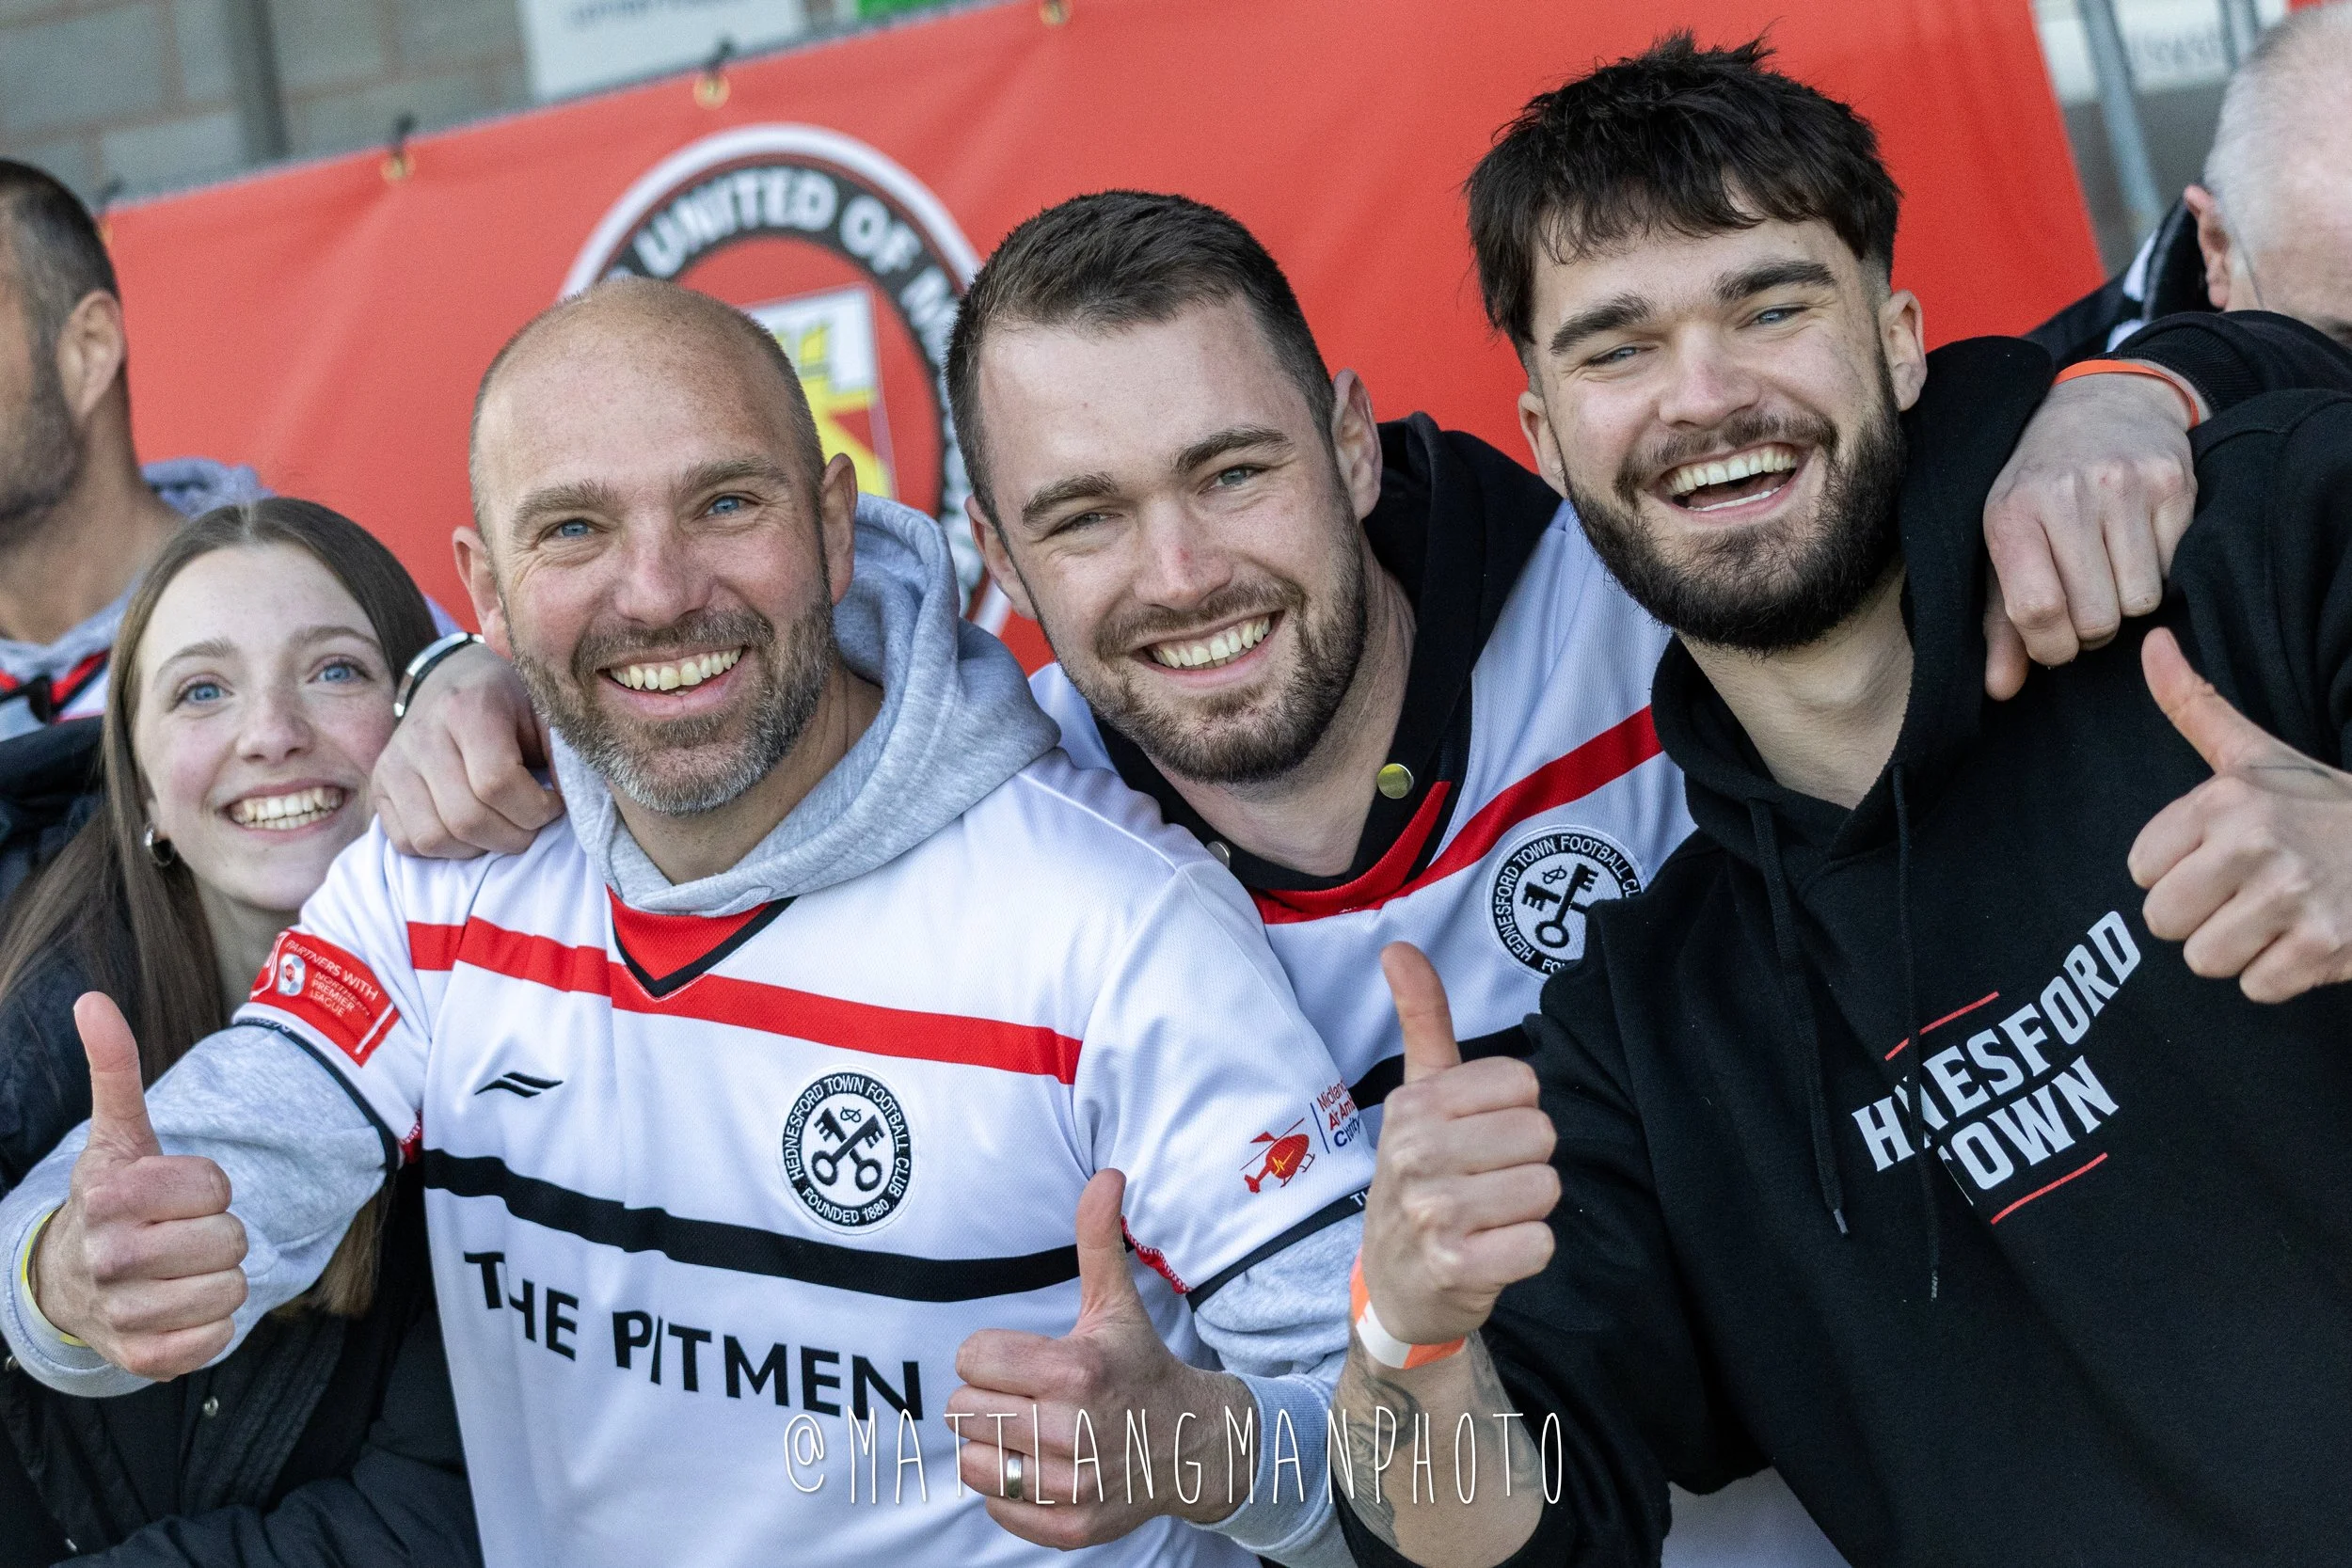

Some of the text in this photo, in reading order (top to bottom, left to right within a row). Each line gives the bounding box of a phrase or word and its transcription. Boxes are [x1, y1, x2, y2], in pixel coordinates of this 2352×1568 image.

[636, 167, 925, 277] UNITED OF
[1495, 835, 1641, 963] HEDNESFORD TOWN FOOTBALL CL
[285, 939, 379, 1002] PARTNERS WITH
[309, 989, 346, 1018] LEAGUE
[311, 978, 356, 1013] PREMIER
[1851, 911, 2142, 1172] HESFORD
[785, 1075, 910, 1197] HEDNESFORD TOWN FOOTBALL CLUB
[1937, 1055, 2120, 1207] OWN
[802, 1186, 890, 1224] FOUNDED 1880
[463, 1251, 924, 1421] THE PITMEN
